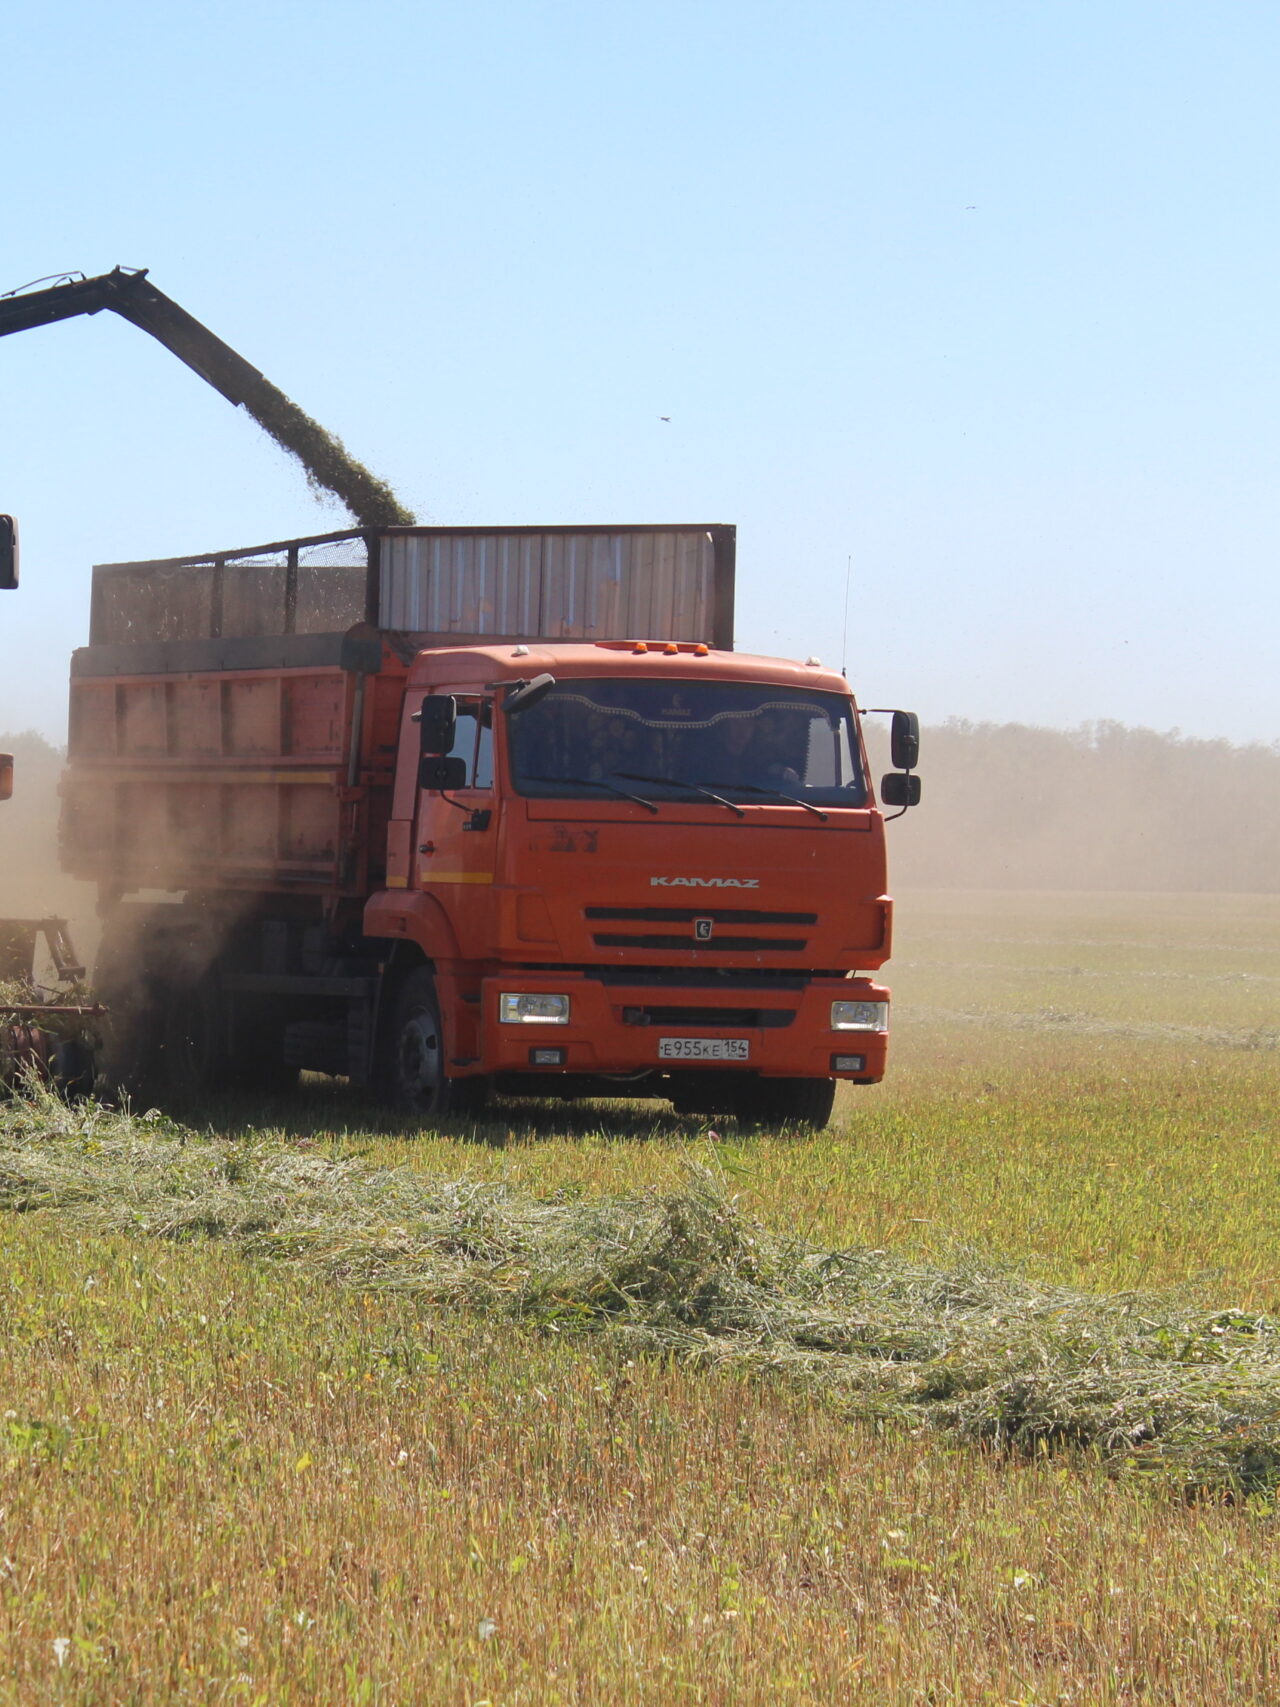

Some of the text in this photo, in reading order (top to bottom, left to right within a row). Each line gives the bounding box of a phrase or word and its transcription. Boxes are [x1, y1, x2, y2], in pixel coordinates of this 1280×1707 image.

[650, 877, 760, 889] KAMAZ
[664, 1041, 747, 1057] E955KE 154
